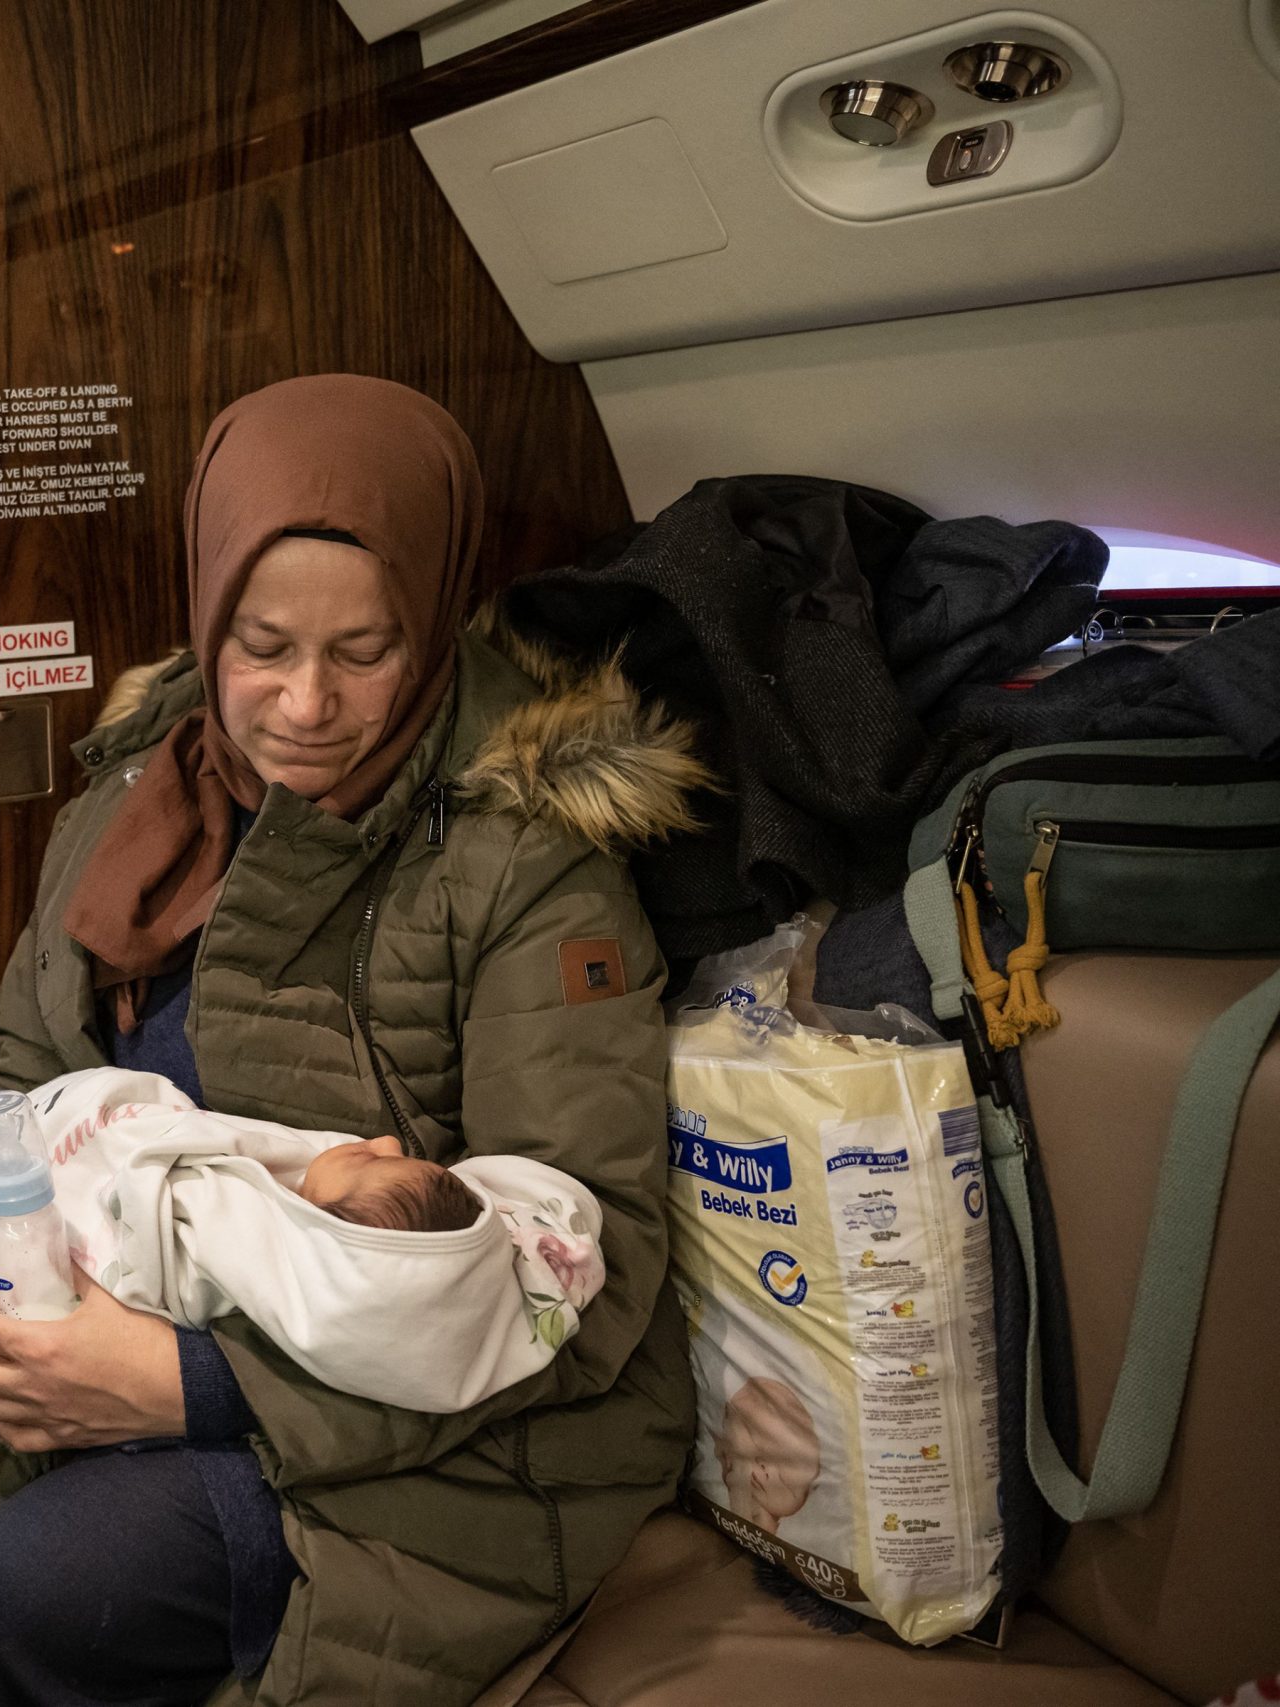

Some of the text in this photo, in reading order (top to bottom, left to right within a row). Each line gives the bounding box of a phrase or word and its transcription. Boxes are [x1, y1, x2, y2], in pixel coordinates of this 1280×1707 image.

[3, 386, 58, 399] TAKE-OFF
[60, 386, 68, 397] &
[70, 384, 118, 396] LANDING
[11, 400, 68, 412] OCCUPIED
[70, 399, 85, 410] AS
[86, 398, 95, 409] A
[97, 397, 133, 409] BERTH
[5, 414, 58, 426] HARNESS
[60, 412, 90, 424] MUST
[92, 411, 107, 422] BE
[2, 427, 58, 440] FORWARD
[60, 424, 118, 437] SHOULDER
[18, 440, 56, 452] UNDER
[58, 438, 92, 450] DIVAN
[6, 467, 20, 479] VE
[22, 465, 58, 479] İNİŞTE
[60, 462, 92, 475] DİVAN
[94, 461, 130, 473] YATAK
[40, 478, 72, 490] OMUZ
[74, 473, 114, 487] KEMERİ
[116, 472, 145, 485] UÇUŞ
[19, 490, 66, 505] ÜZERİNE
[68, 488, 112, 501] TAKILIR.
[113, 487, 136, 498] CAN
[42, 501, 107, 516] ALTINDADIR
[6, 665, 87, 692] İÇİLMEZ
[692, 1142, 709, 1170] &
[716, 1149, 773, 1193] Willy
[829, 1154, 902, 1170] Jenny & Willy
[701, 1190, 798, 1226] Bebek Bezi
[711, 1508, 786, 1560] Yenidoğan
[807, 1556, 832, 1582] 40
